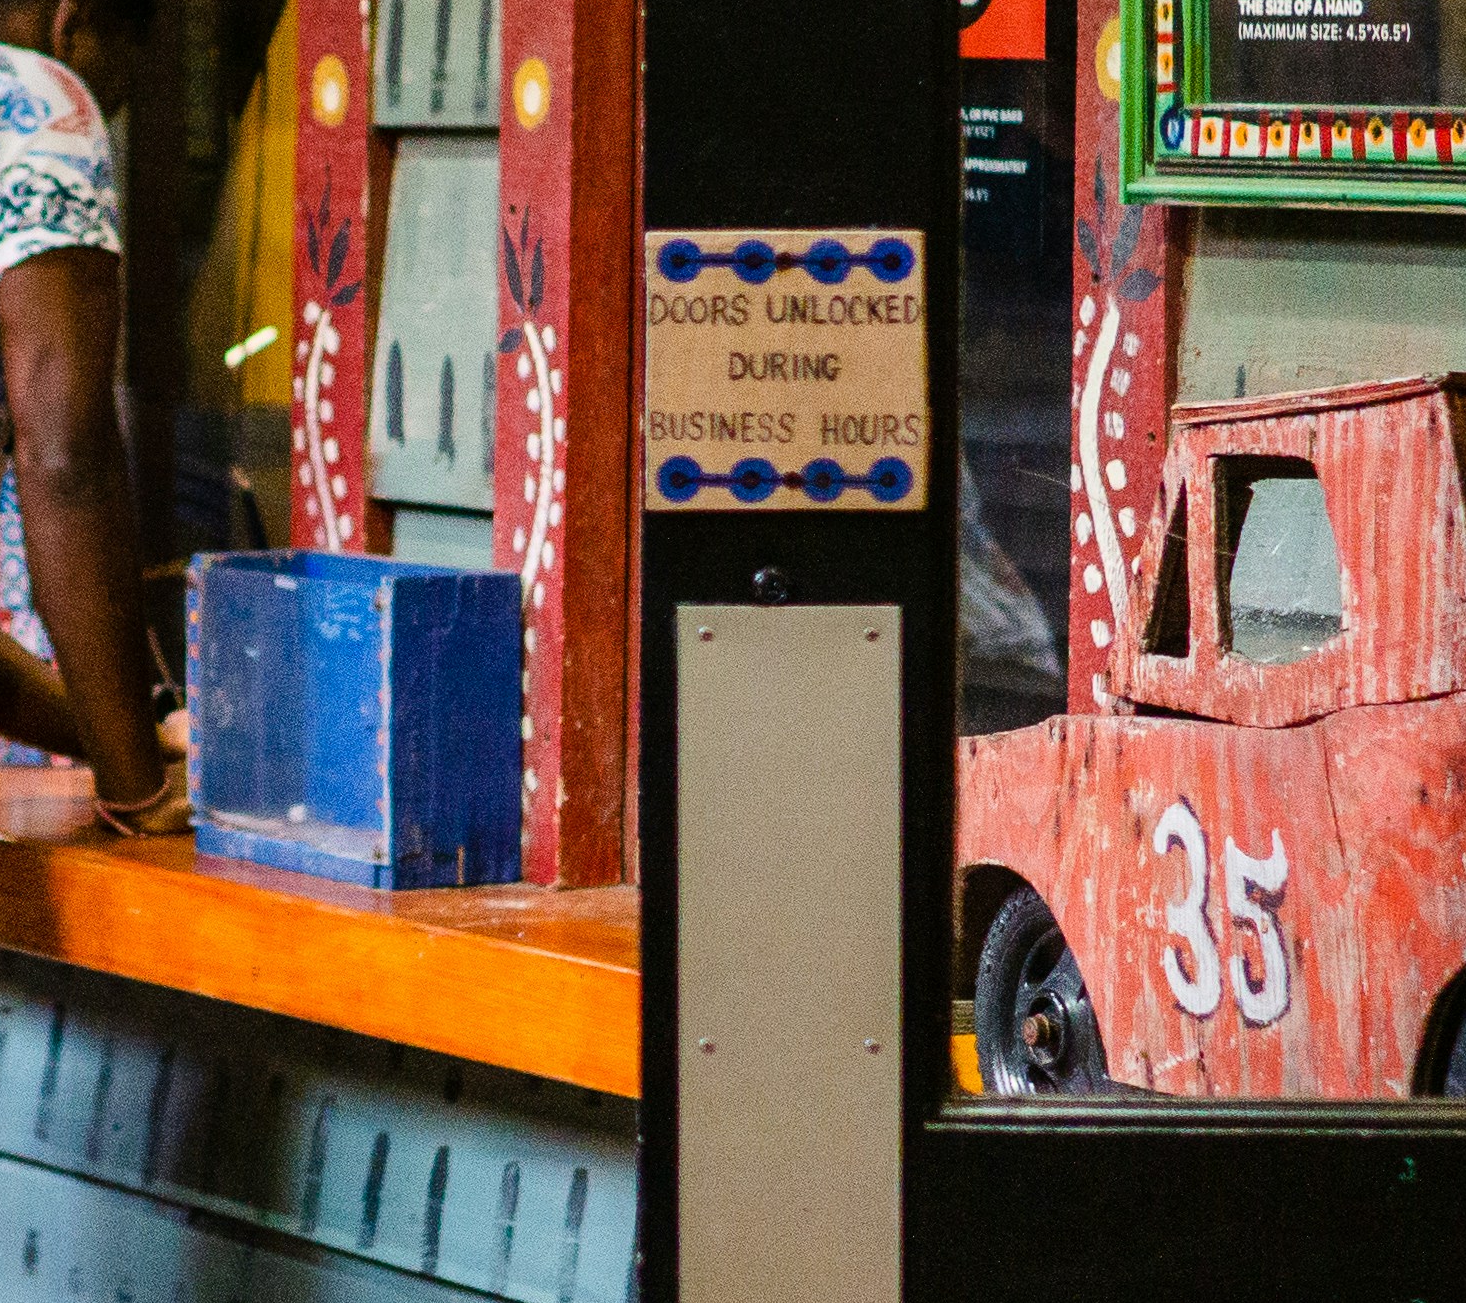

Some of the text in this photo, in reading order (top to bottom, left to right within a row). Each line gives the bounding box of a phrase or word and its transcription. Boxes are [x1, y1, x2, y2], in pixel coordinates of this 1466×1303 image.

[1238, 22, 1307, 42] (MAXIMUM
[1311, 22, 1344, 41] SIZE:
[650, 294, 918, 327] DOORS UNLOCKED
[728, 351, 842, 382] DURING
[649, 411, 921, 446] BUSINESS HOURS
[1152, 796, 1291, 1027] 35
